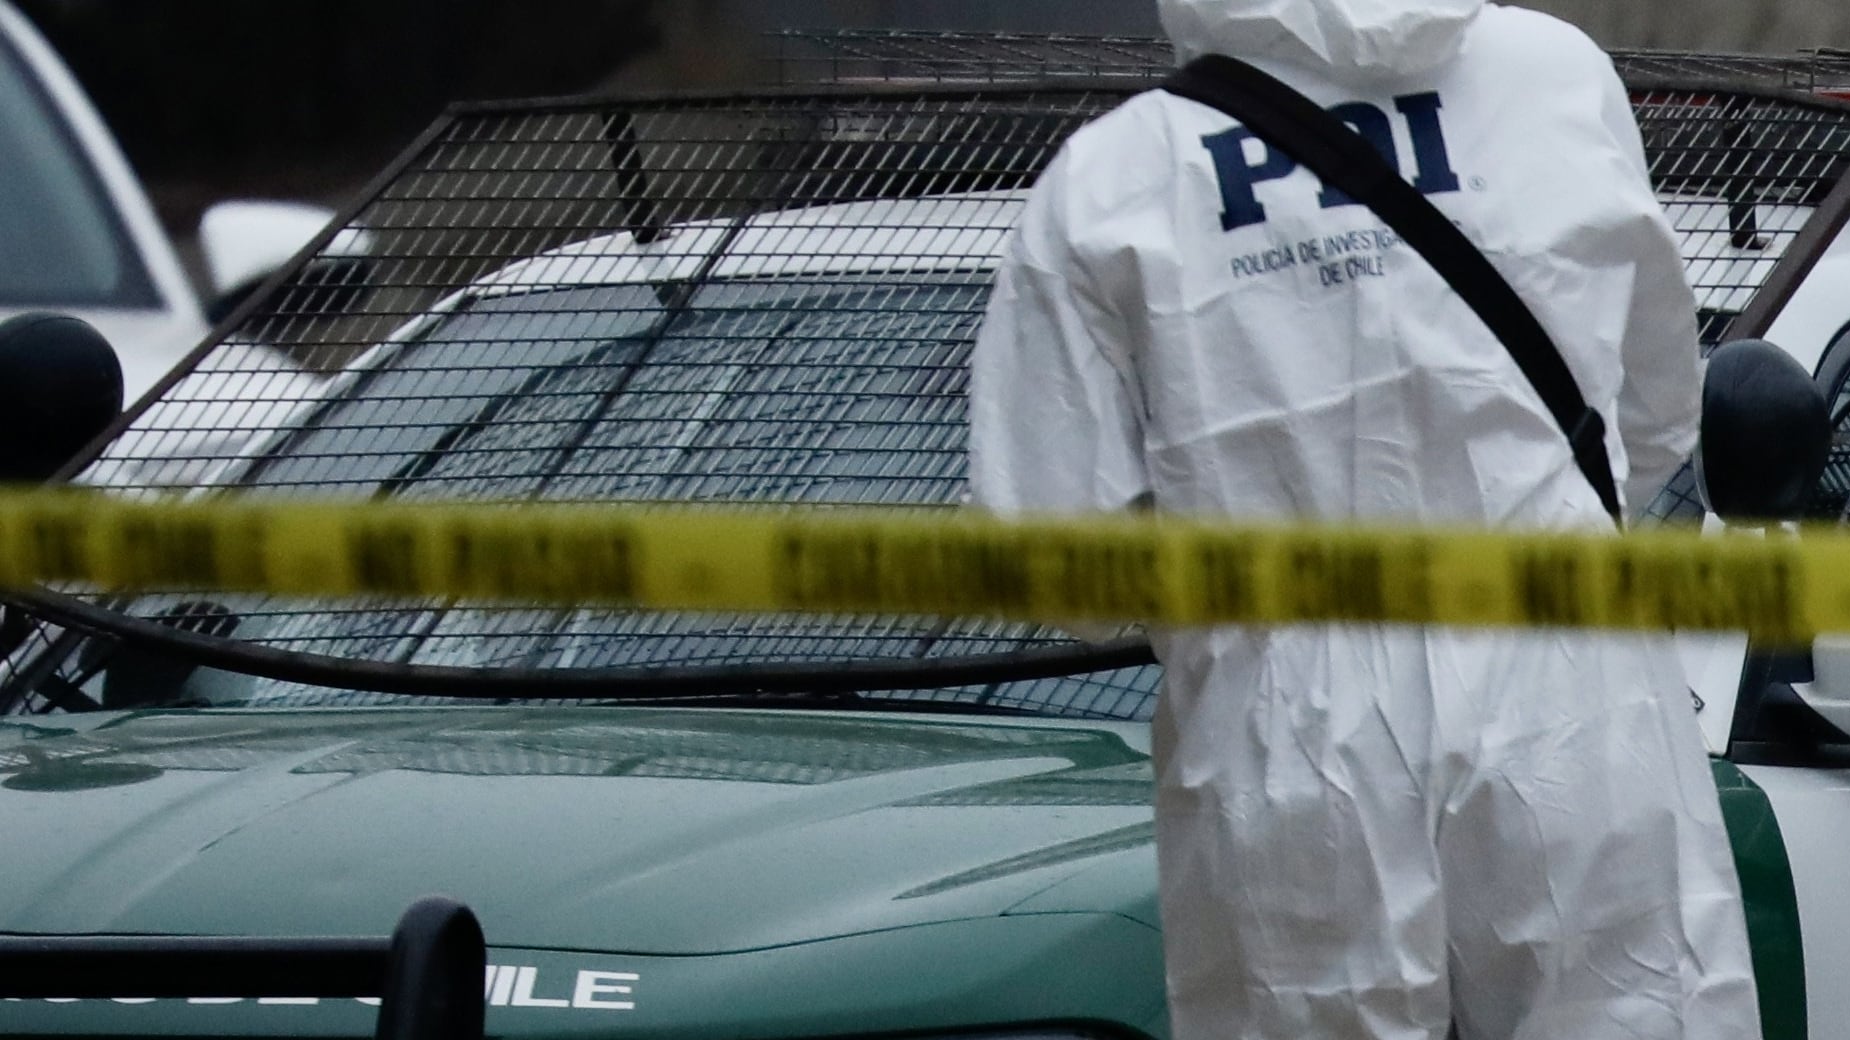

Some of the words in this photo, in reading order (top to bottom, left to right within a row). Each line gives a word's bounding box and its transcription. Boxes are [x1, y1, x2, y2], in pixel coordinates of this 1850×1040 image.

[1298, 239, 1321, 263] DE
[1319, 261, 1343, 286] DE
[1345, 255, 1385, 280] CHILE
